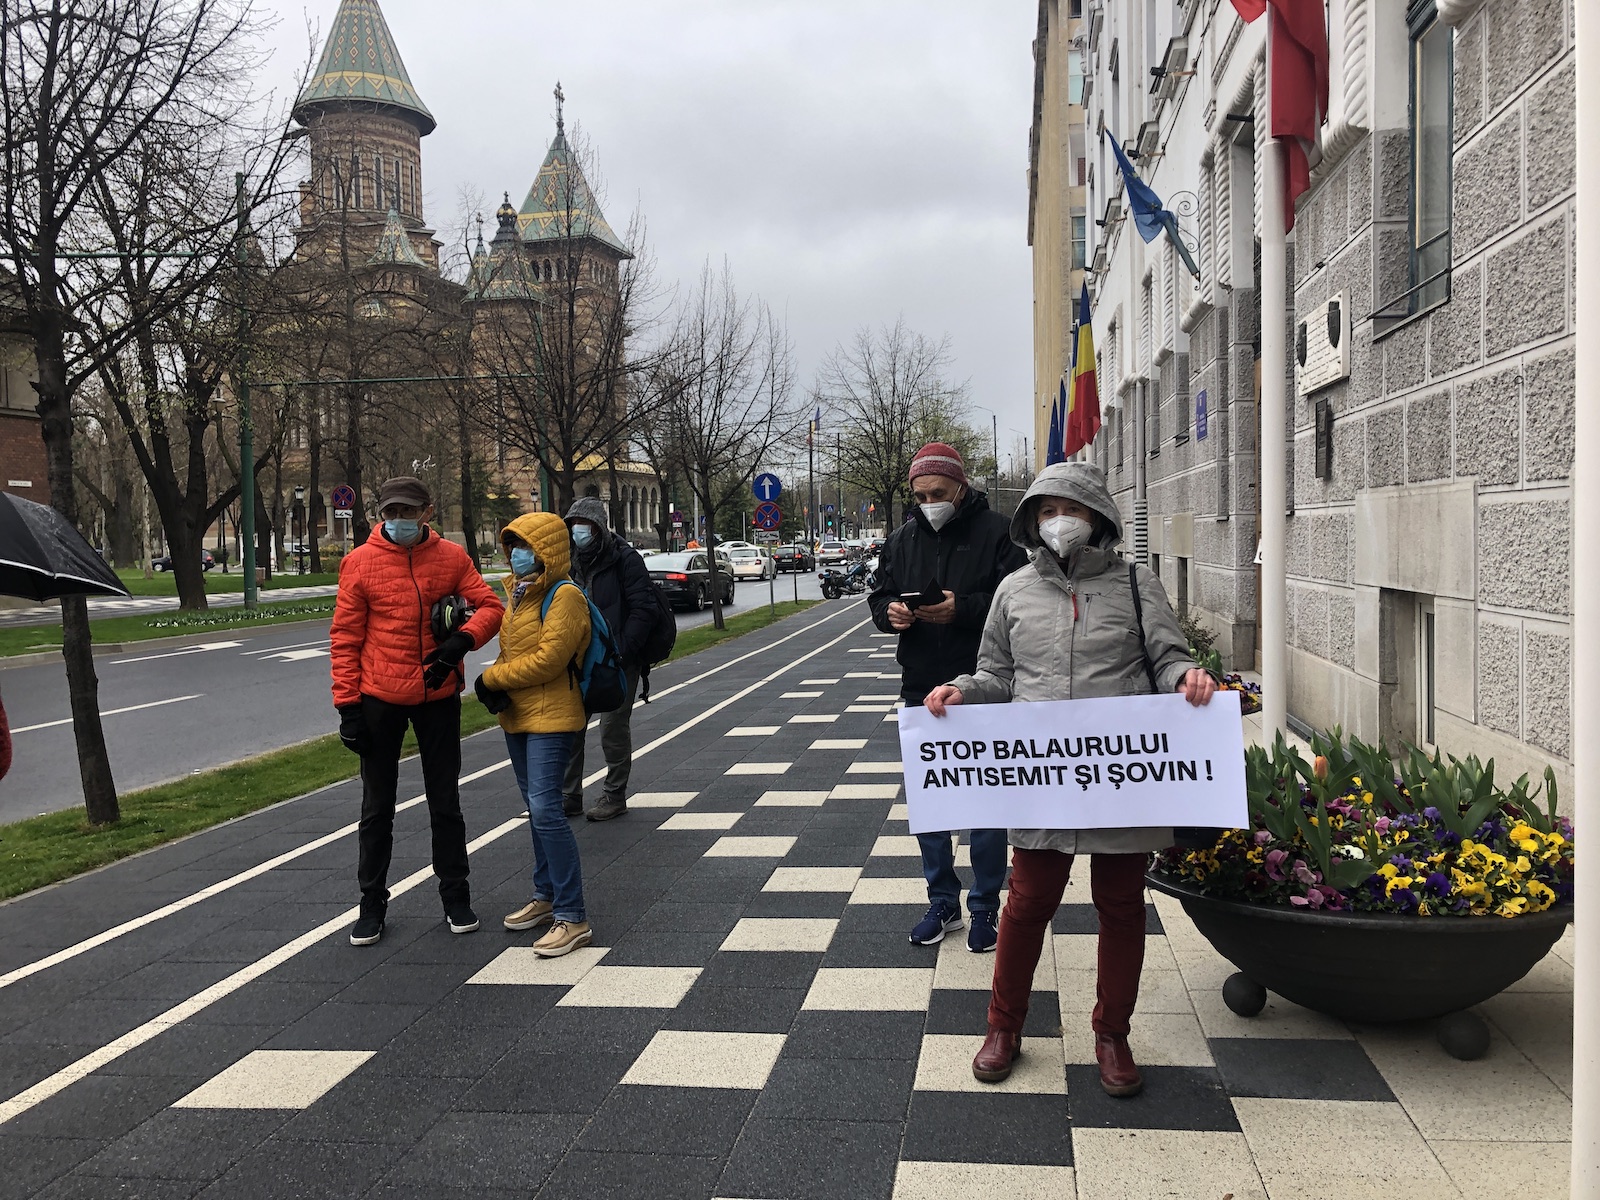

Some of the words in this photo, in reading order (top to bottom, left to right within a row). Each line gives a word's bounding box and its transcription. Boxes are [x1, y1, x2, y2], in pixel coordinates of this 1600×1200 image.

[919, 740, 987, 762] STOP
[993, 733, 1169, 760] BALAURULUI
[923, 766, 1068, 789] ANTISEMIT
[1205, 759, 1214, 782] !
